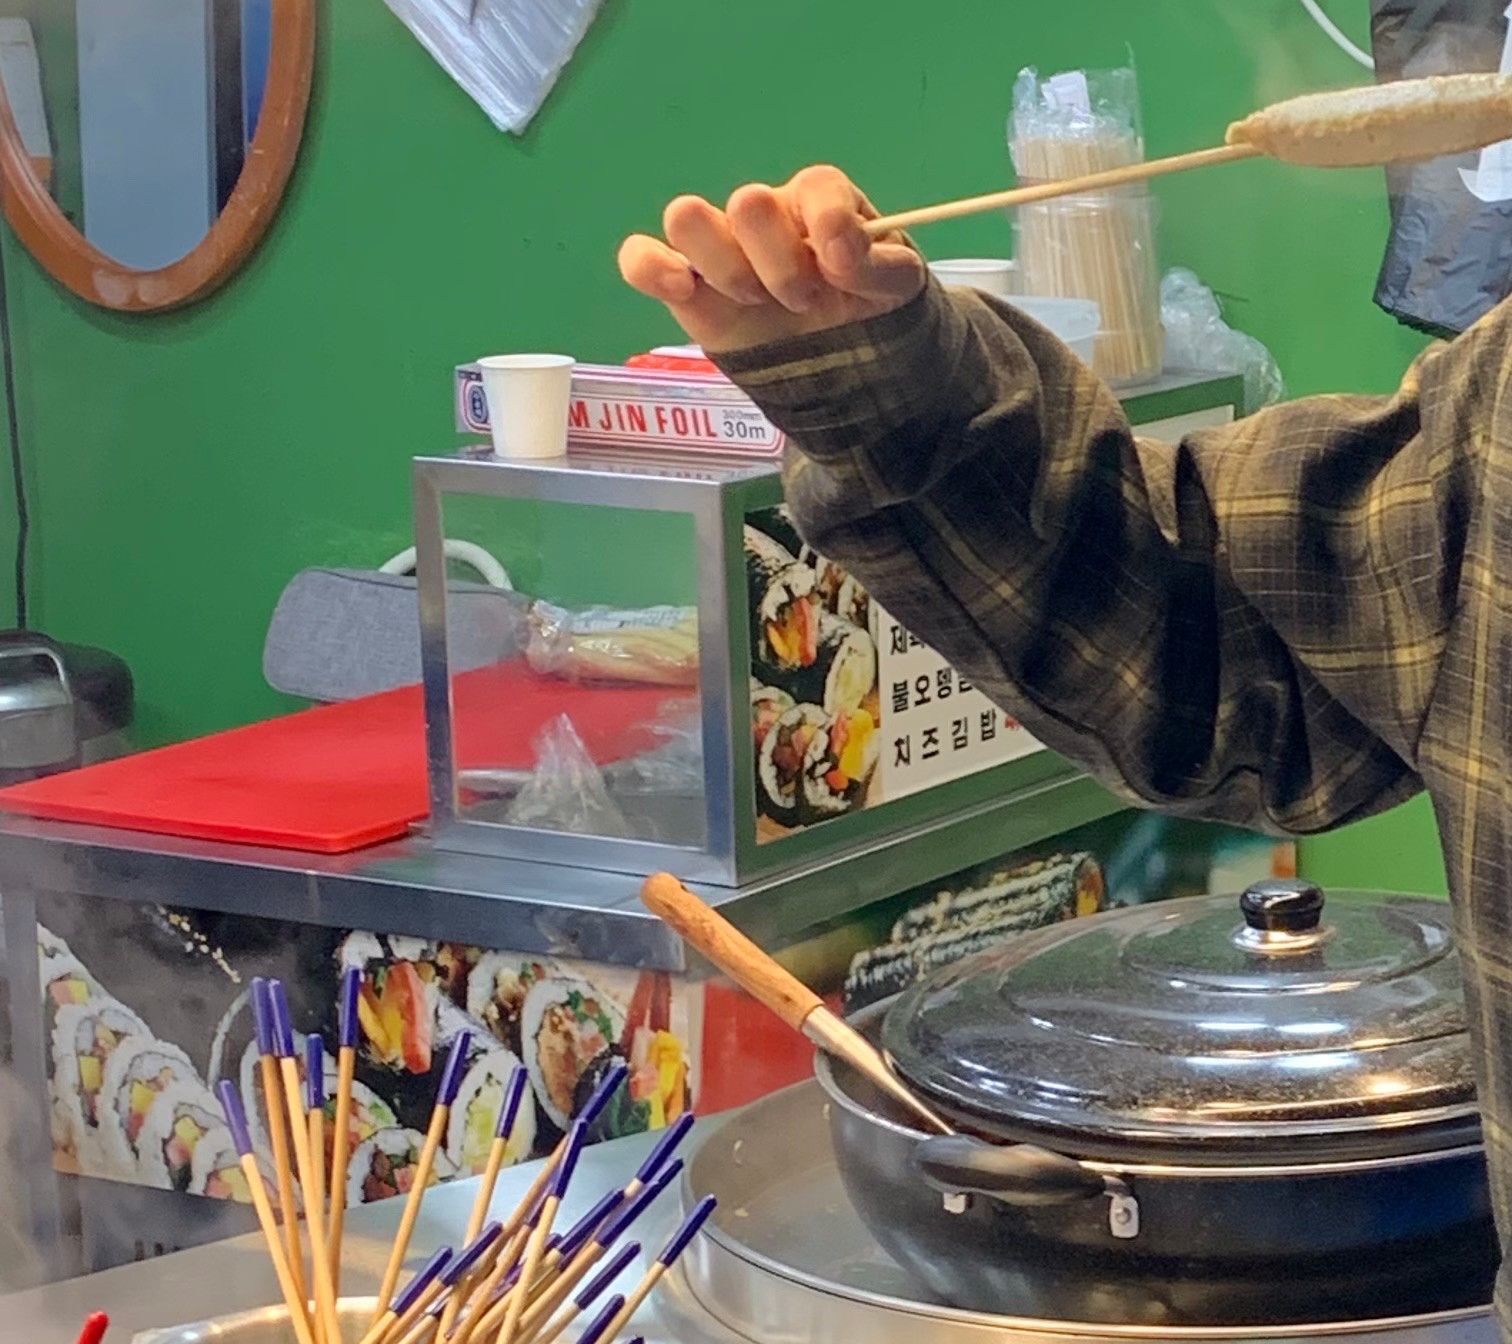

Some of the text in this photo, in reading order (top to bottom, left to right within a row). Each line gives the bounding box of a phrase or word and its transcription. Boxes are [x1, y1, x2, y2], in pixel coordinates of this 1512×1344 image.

[600, 402, 647, 433] JIN
[655, 406, 718, 438] FOIL
[722, 421, 766, 439] 30m
